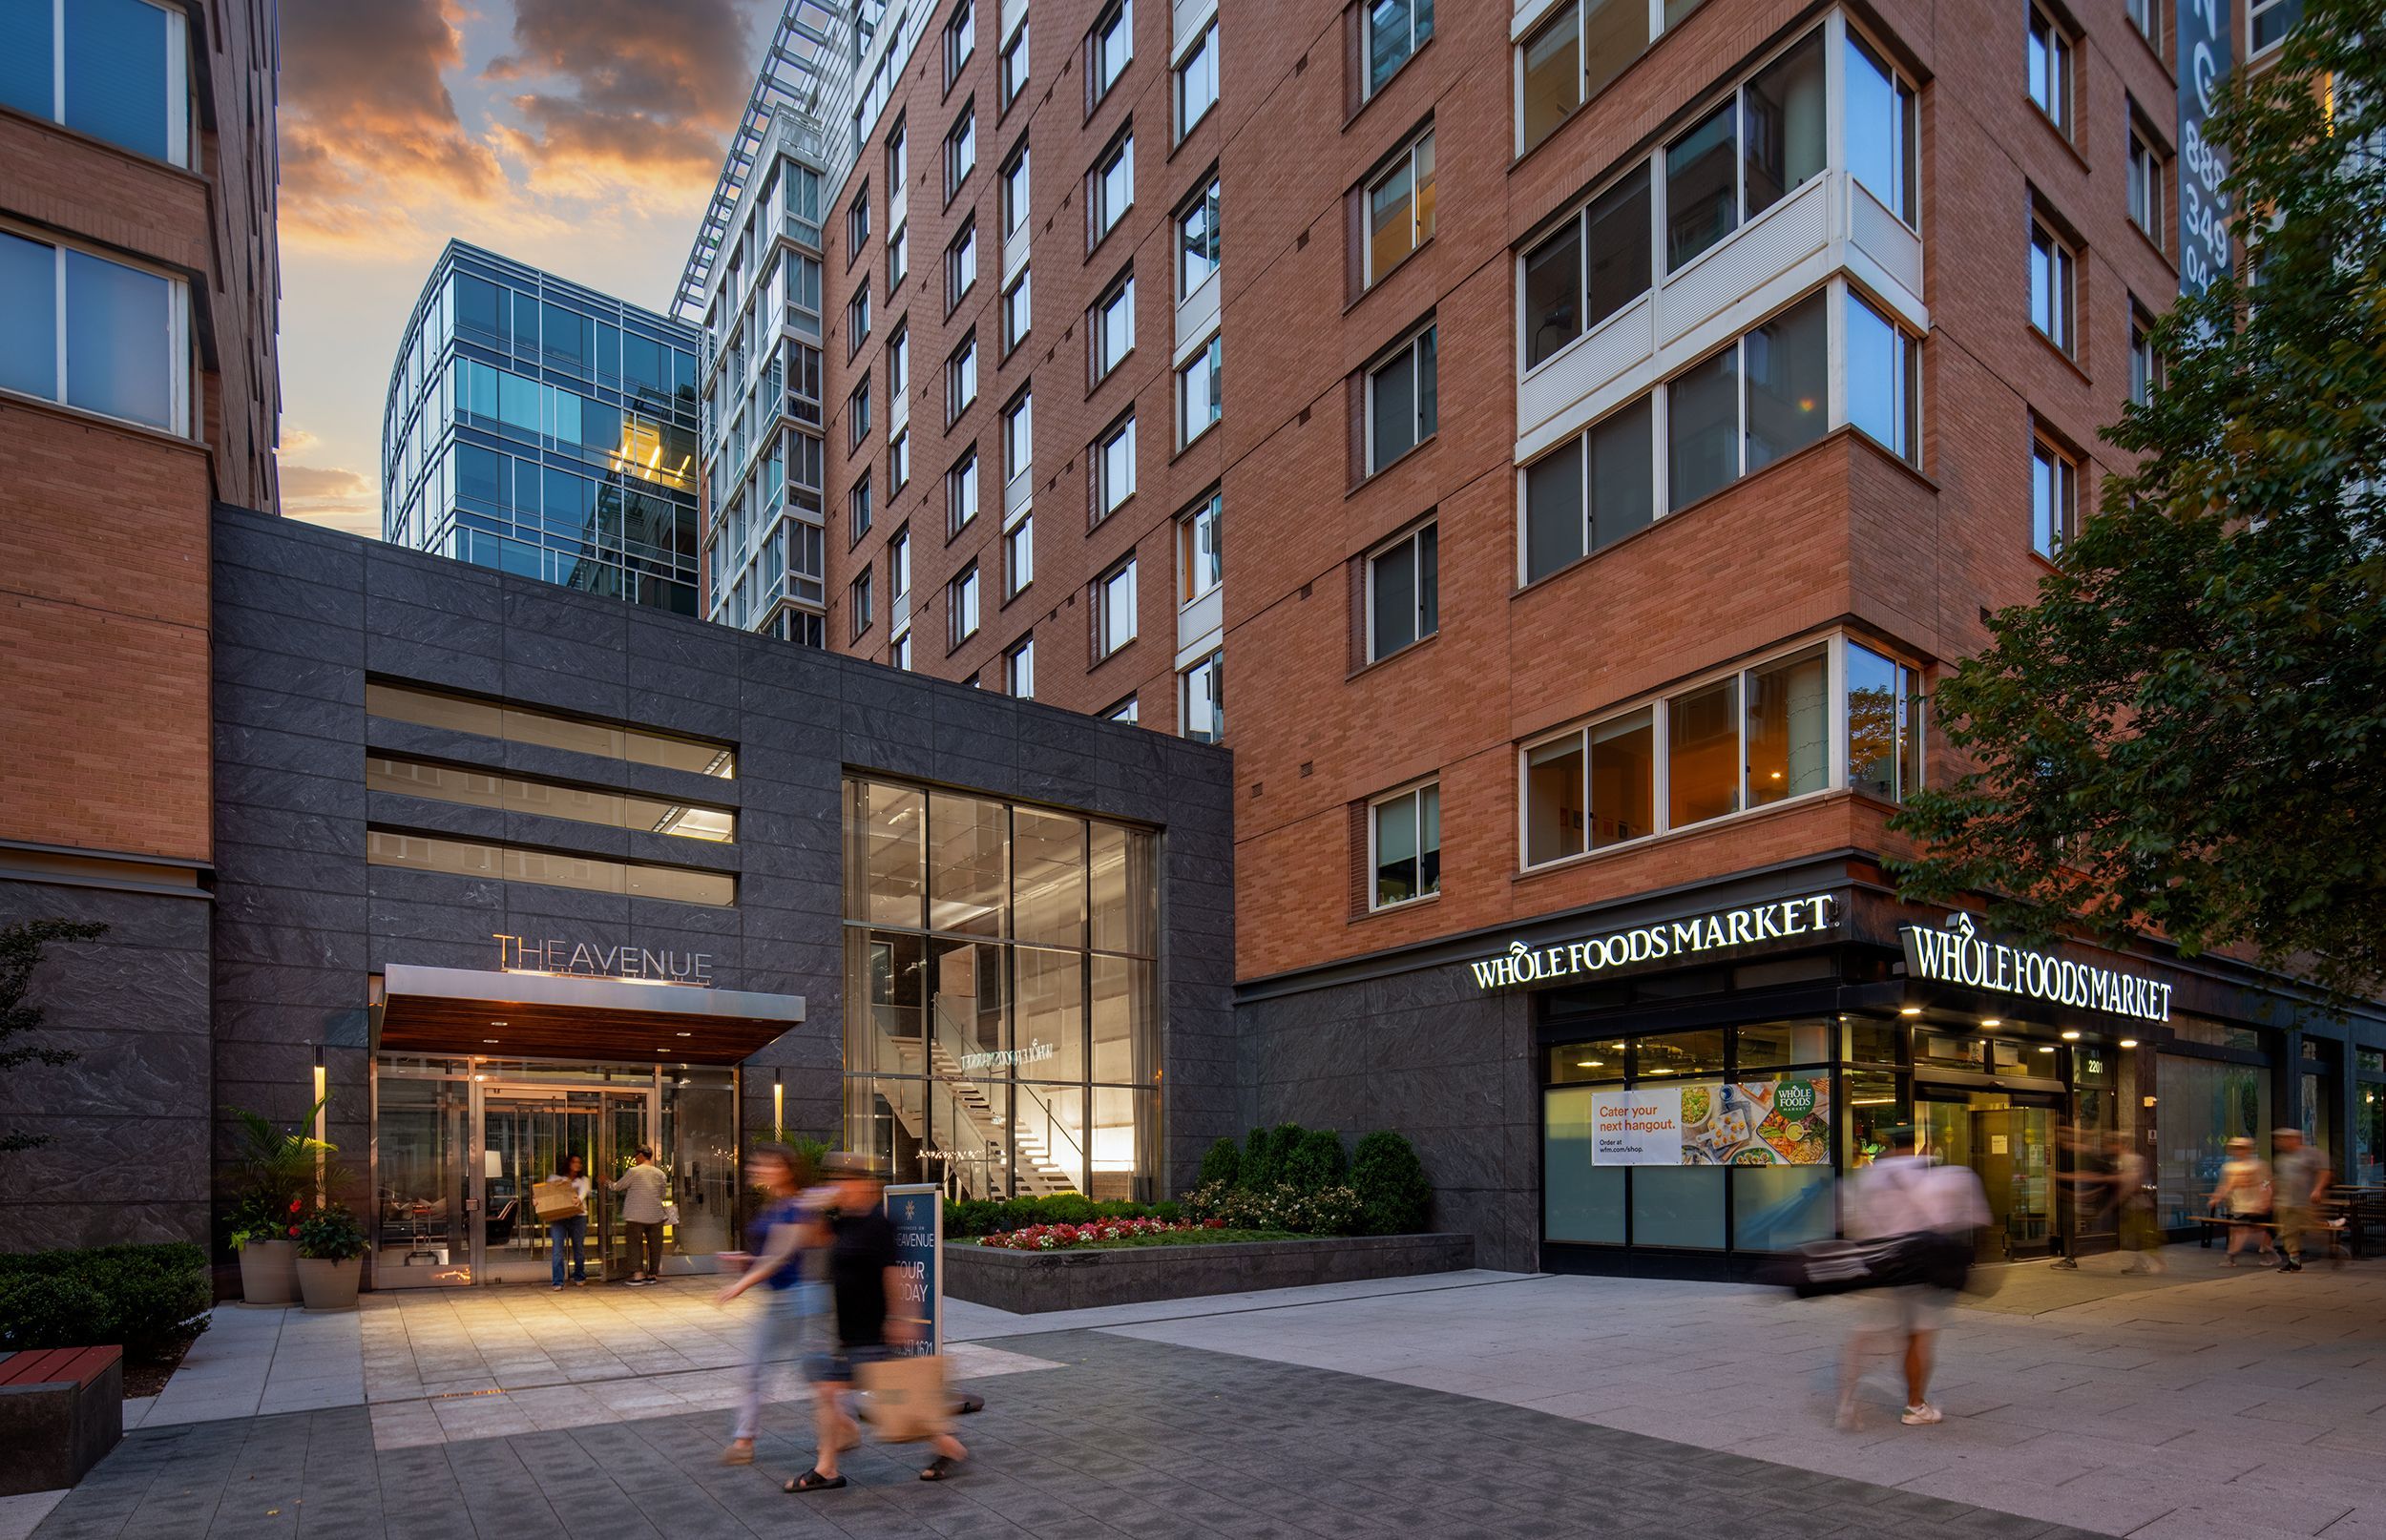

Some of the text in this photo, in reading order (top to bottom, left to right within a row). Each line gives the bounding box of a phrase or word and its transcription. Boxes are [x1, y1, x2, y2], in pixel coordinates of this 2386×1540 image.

[2186, 182, 2229, 269] 349
[1471, 893, 1833, 989] WHOLE FOODS MARKET
[1912, 911, 2172, 1023] WHOLE FOODS MARKET
[2088, 1059, 2103, 1073] 2201
[1778, 1085, 1812, 1098] WHOLE
[1780, 1097, 1811, 1107] FOODS
[1600, 1106, 1658, 1119] Cater your
[1600, 1118, 1676, 1134] next hangout.
